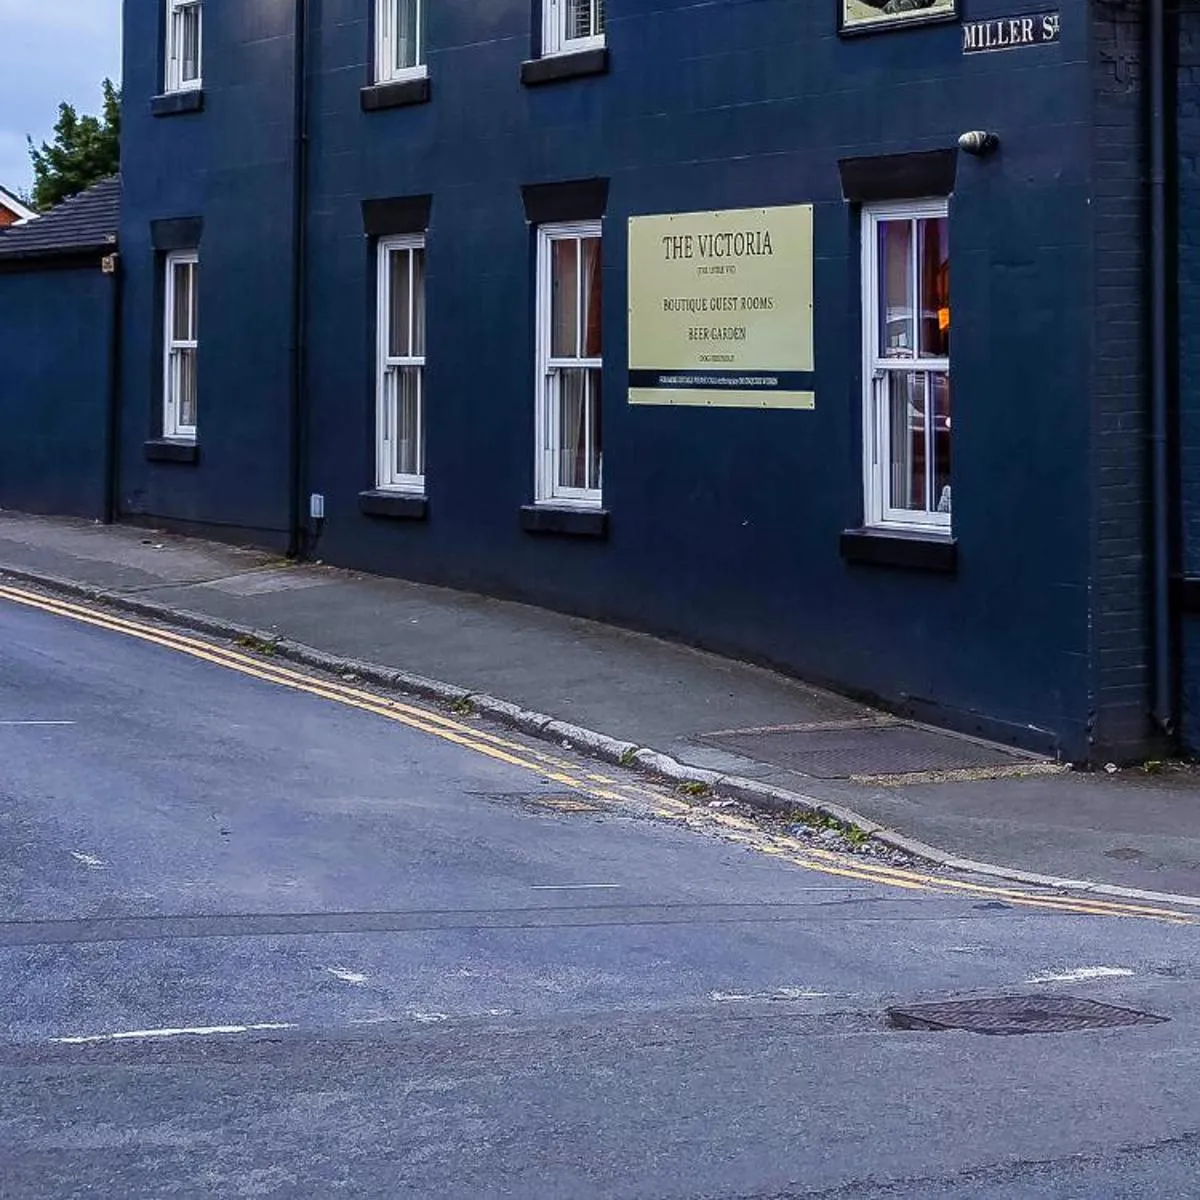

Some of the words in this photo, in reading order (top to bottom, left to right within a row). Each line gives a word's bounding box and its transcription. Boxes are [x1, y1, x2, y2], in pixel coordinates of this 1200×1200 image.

[963, 18, 1034, 49] MILLER
[662, 235, 693, 260] THE
[698, 230, 773, 258] VICTORIA
[663, 298, 708, 313] BOUTIQUE
[710, 297, 738, 311] GUEST
[741, 296, 774, 310] ROOMS
[688, 327, 709, 341] BEER
[711, 327, 746, 341] GARDEN
